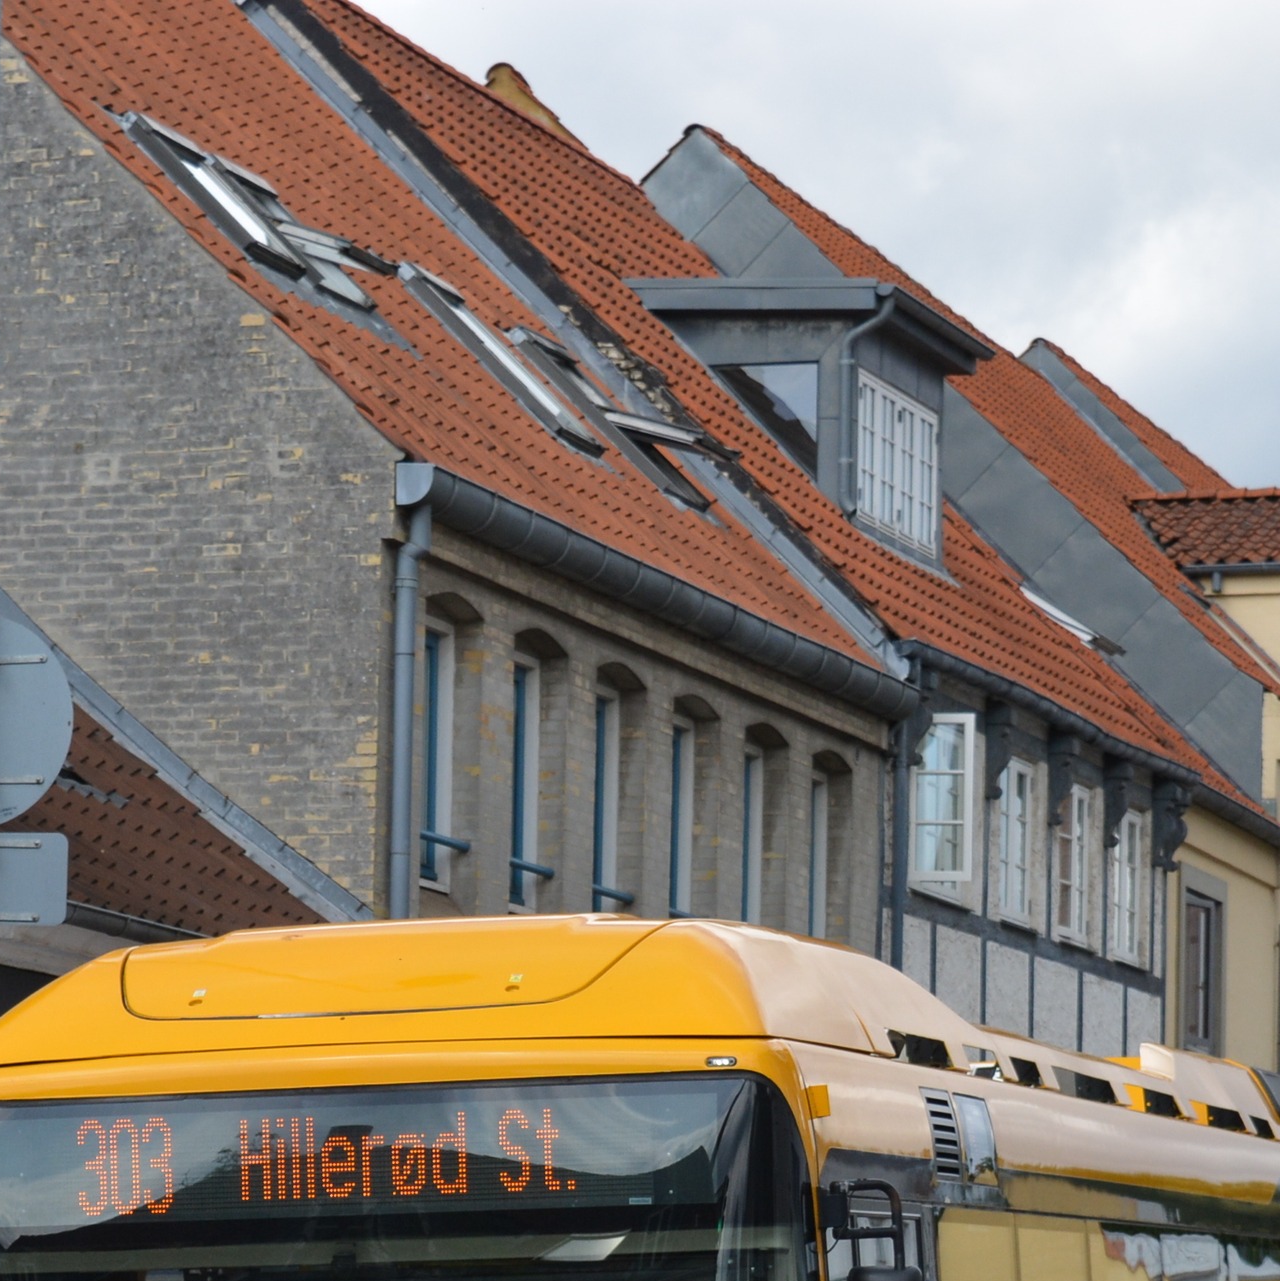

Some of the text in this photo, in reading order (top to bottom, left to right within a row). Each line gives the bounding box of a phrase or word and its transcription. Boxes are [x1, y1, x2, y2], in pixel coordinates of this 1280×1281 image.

[76, 1108, 576, 1216] 303 Hillerød St.
